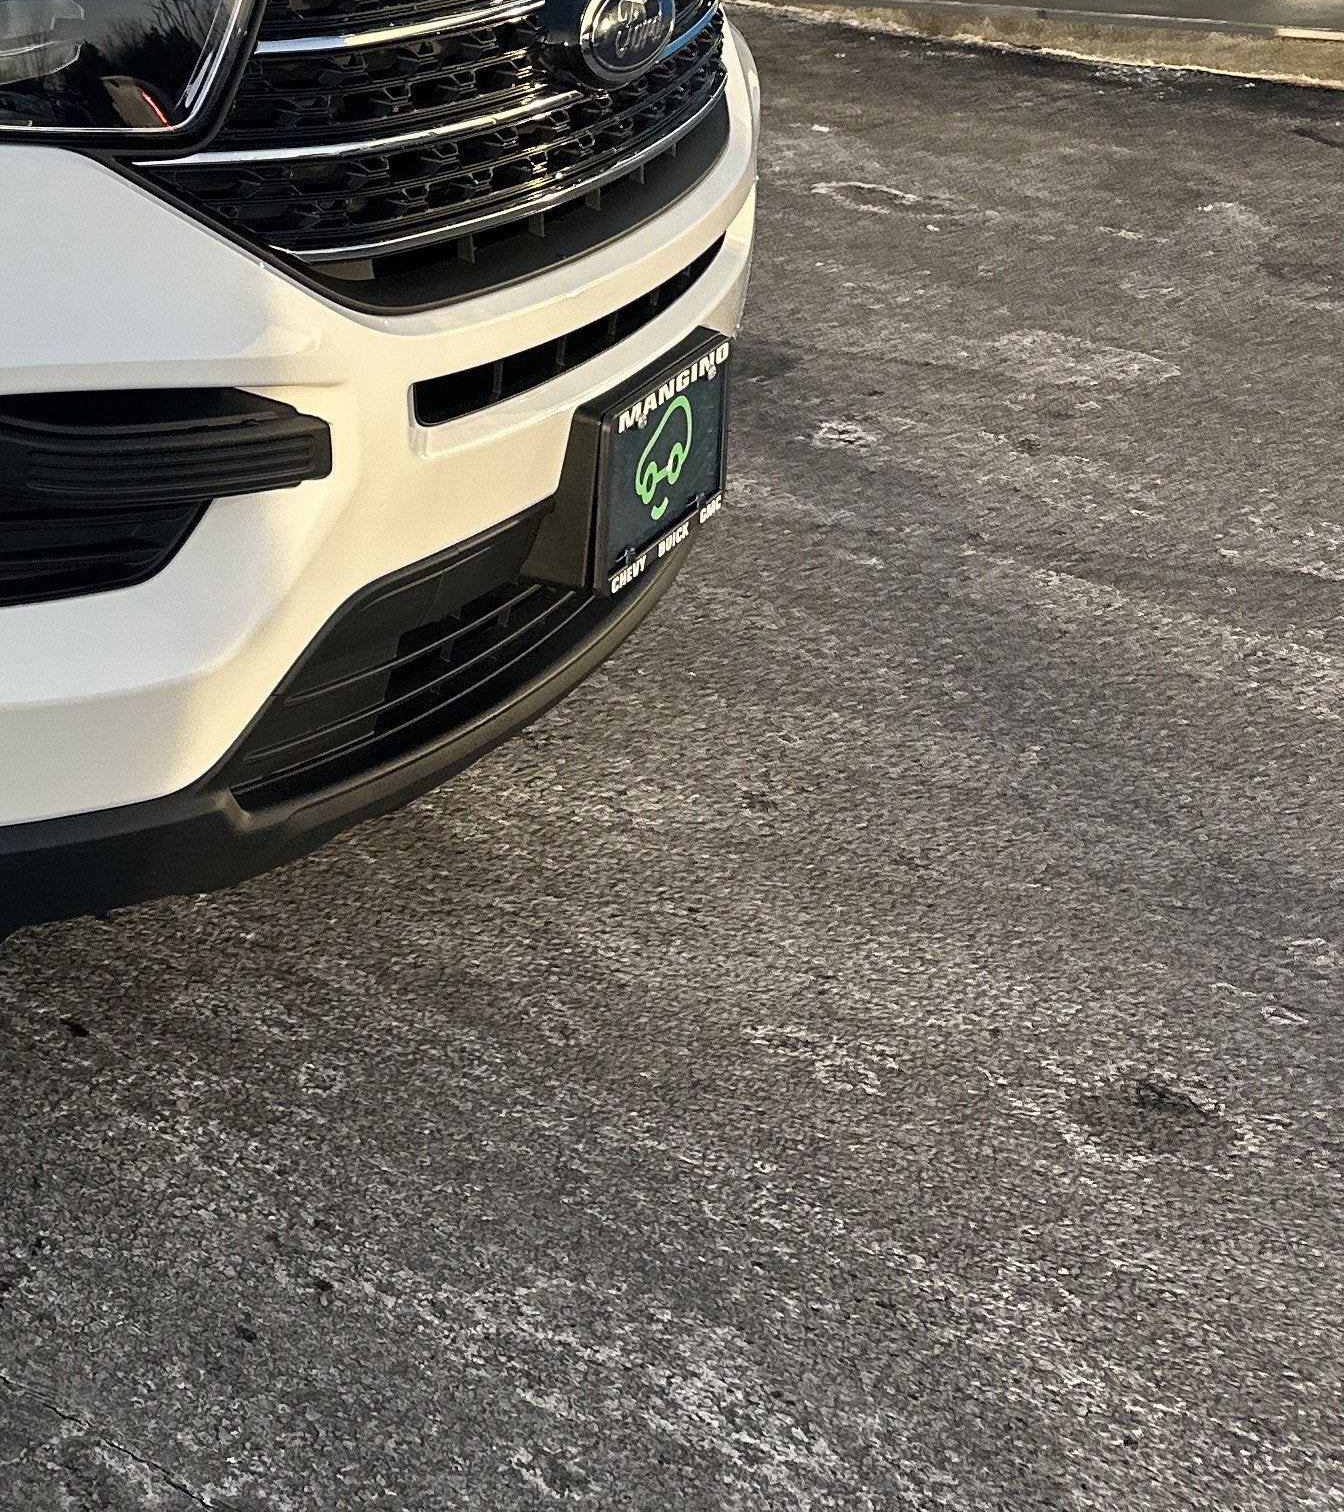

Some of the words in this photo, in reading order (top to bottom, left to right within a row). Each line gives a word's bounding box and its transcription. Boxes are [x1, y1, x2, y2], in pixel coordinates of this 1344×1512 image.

[618, 342, 730, 434] MANGINO
[611, 554, 646, 595] CHEVY
[699, 495, 723, 525] GMC
